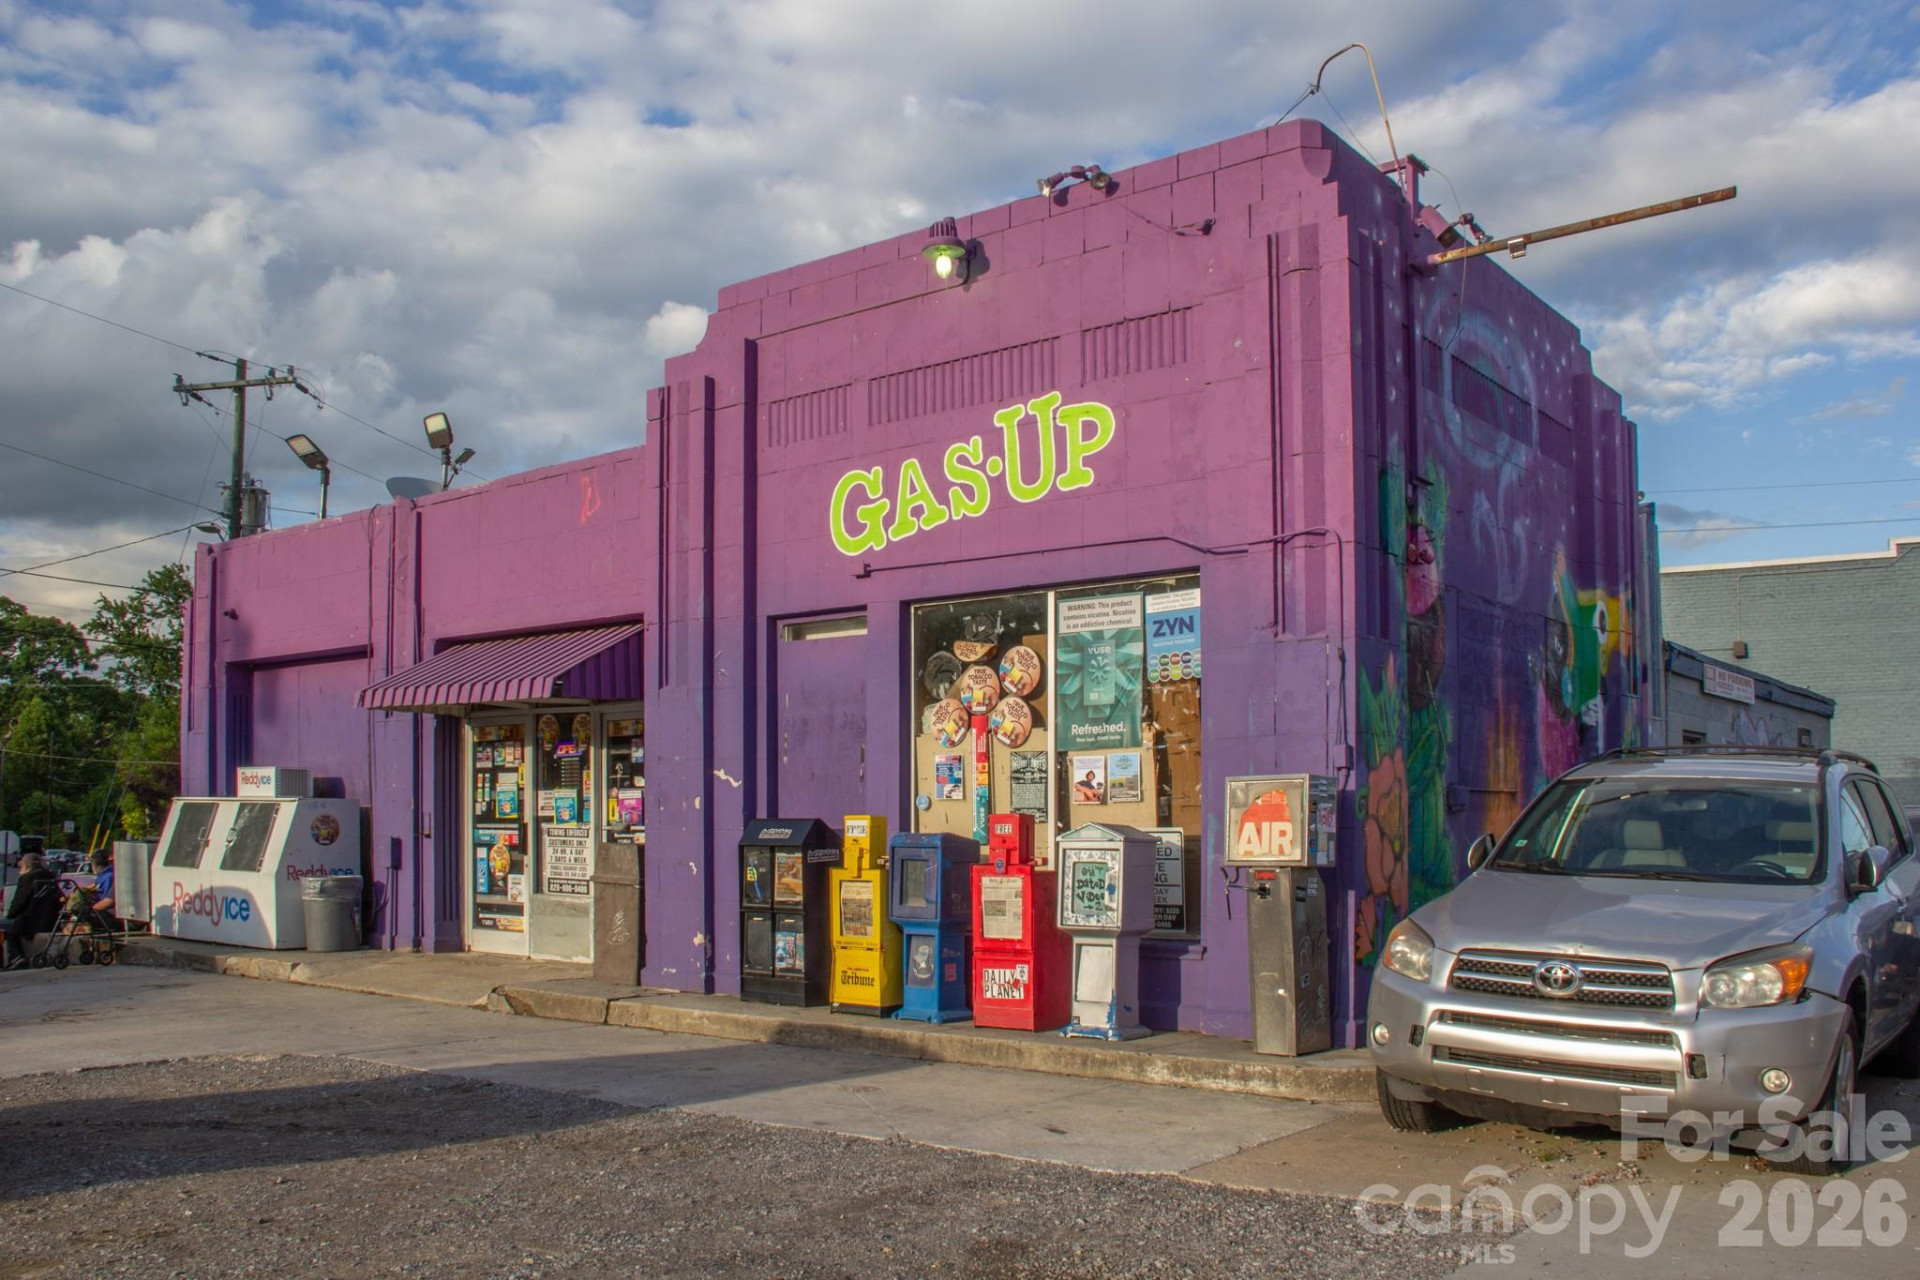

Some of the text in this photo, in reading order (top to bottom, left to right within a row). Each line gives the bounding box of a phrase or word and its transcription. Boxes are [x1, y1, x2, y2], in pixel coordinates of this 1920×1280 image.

[1111, 600, 1132, 609] product
[1063, 613, 1086, 621] contains
[1080, 620, 1105, 628] addictive
[1106, 617, 1133, 626] chemical.
[1152, 615, 1194, 638] ZYN
[1015, 649, 1036, 670] TOBACCO
[1023, 648, 1035, 660] TRUE
[1018, 658, 1030, 671] TASTE
[1005, 701, 1027, 719] TOBACCO
[1012, 700, 1024, 709] TRUE
[933, 702, 950, 727] TOBACCO
[1008, 710, 1021, 722] TASTE
[1071, 721, 1126, 736] Refreshed.
[995, 824, 1012, 834] FREE
[1238, 822, 1293, 856] AIR
[841, 970, 875, 986] Tribune
[984, 970, 1016, 984] DAILY
[984, 984, 1024, 999] PLANET
